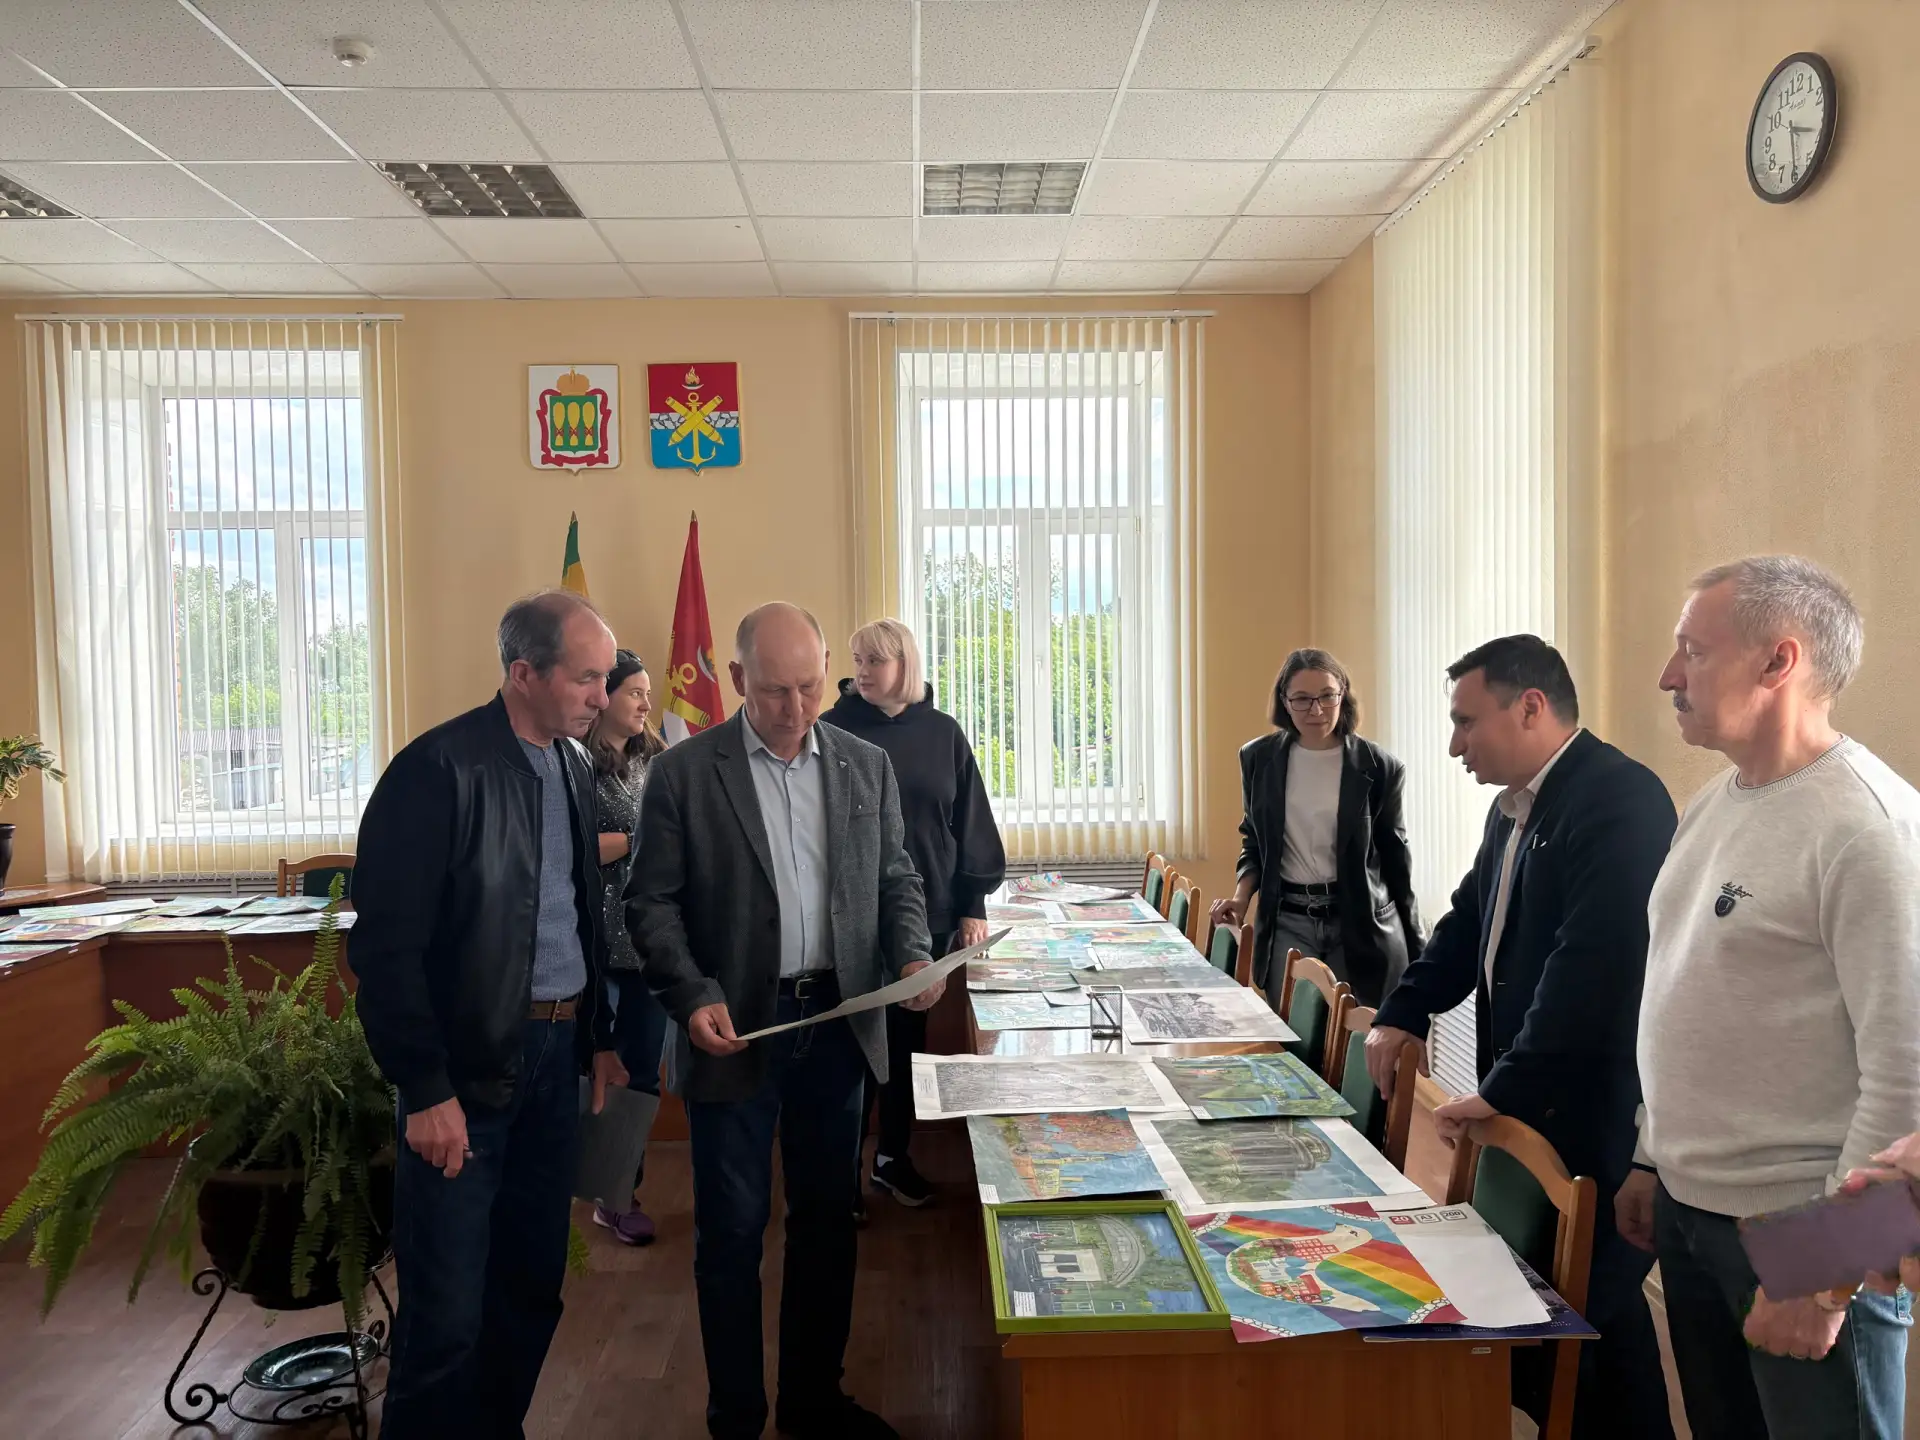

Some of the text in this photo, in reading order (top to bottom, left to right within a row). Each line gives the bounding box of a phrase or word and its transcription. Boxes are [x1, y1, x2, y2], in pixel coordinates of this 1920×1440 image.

[1789, 72, 1804, 96] 12
[1807, 73, 1814, 94] 1
[1778, 88, 1790, 110] 11
[1815, 87, 1822, 106] 2
[1768, 111, 1782, 133] 10
[1764, 136, 1772, 154] 9
[1768, 153, 1776, 172] 8
[1778, 165, 1786, 184] 7
[1791, 165, 1798, 183] 6
